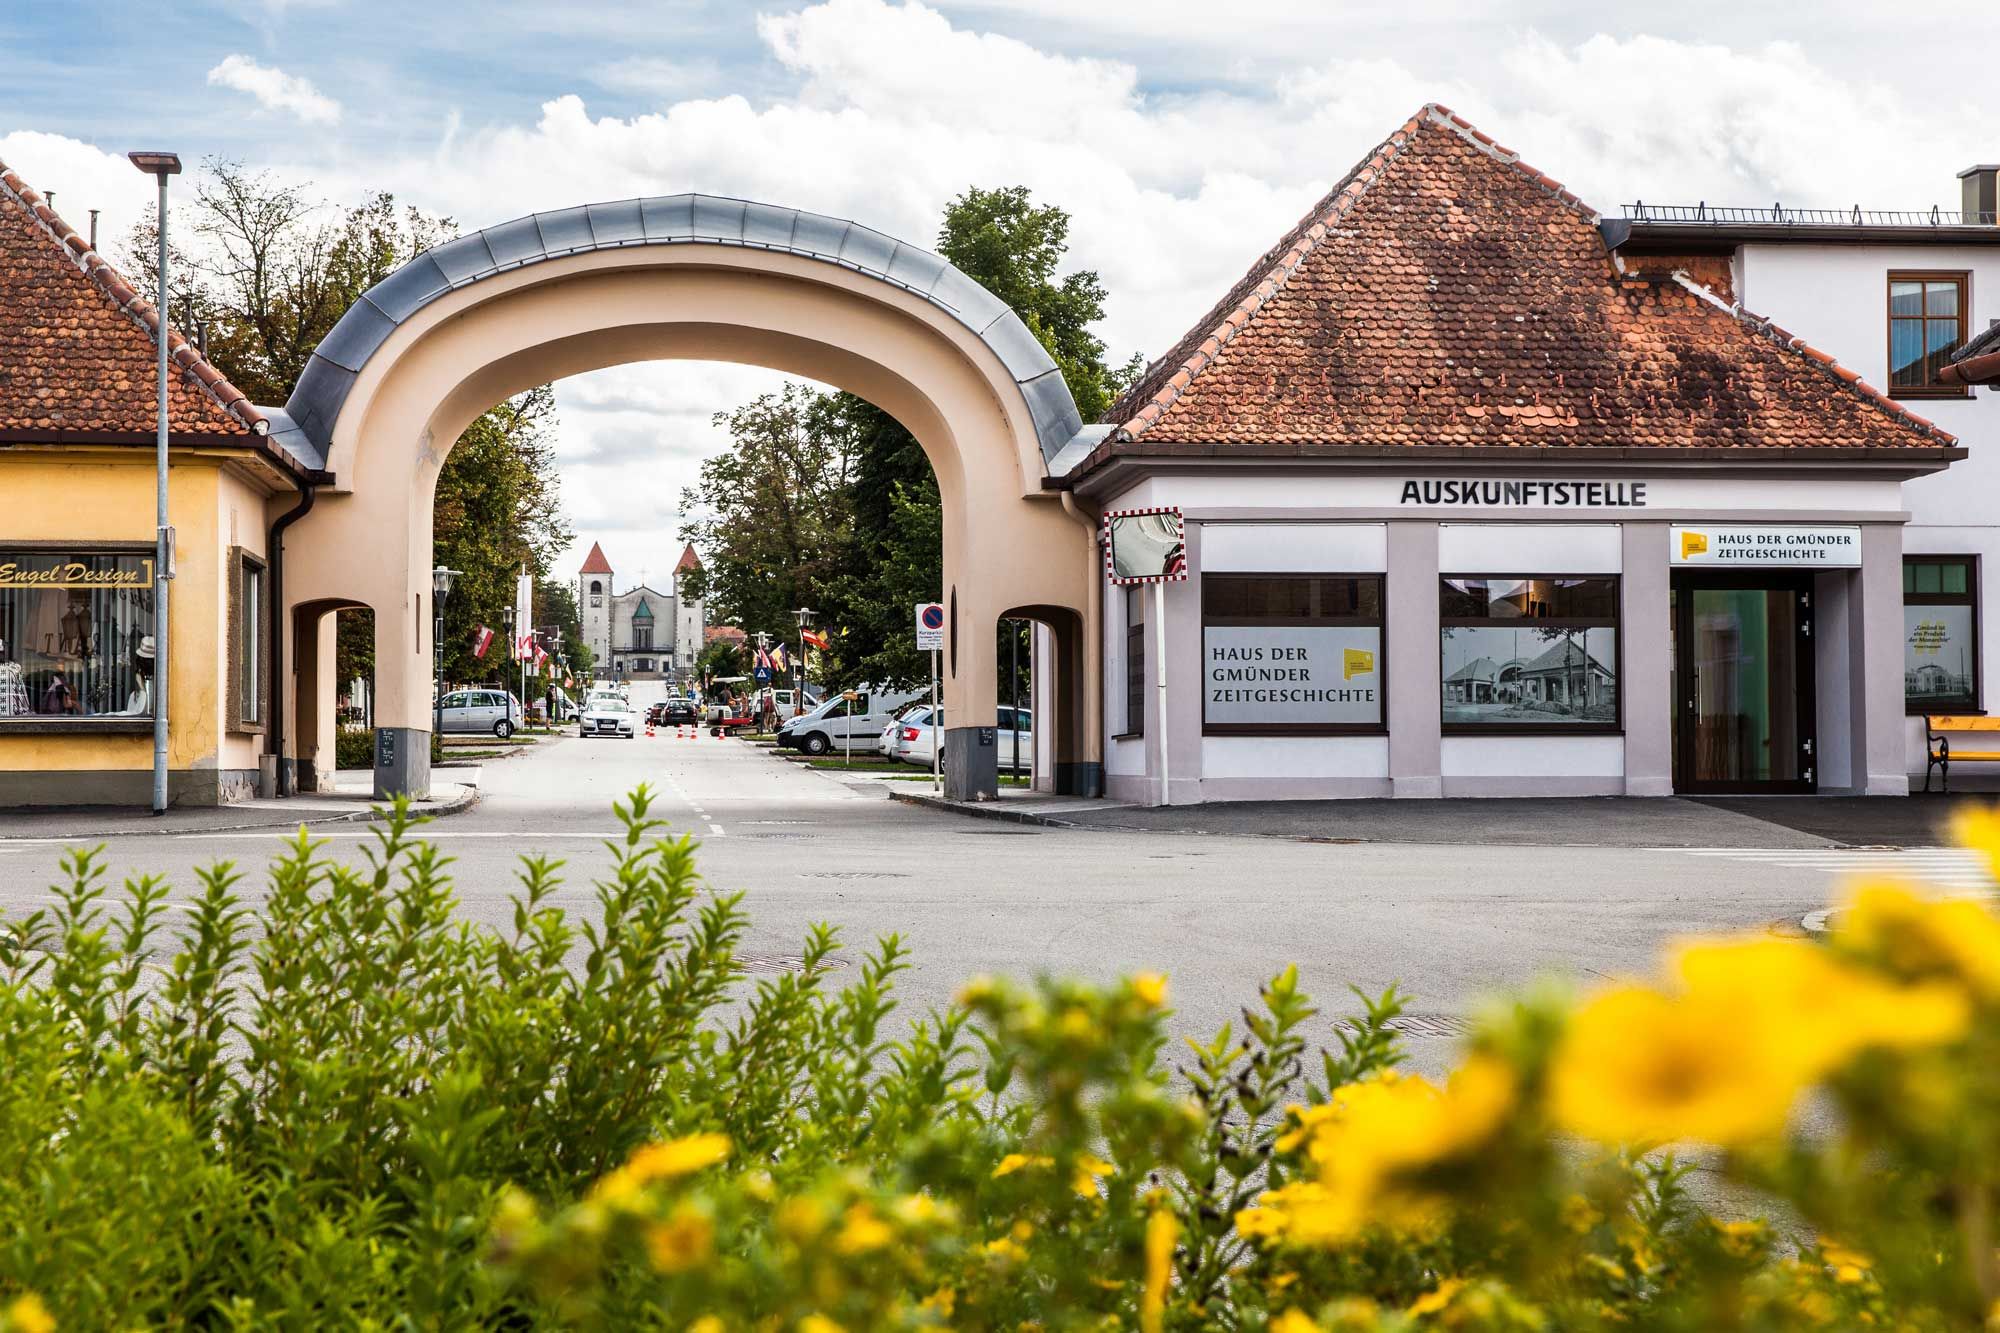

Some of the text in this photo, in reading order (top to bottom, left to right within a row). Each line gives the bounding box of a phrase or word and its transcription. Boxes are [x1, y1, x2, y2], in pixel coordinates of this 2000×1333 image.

[1401, 480, 1647, 506] AUSKUNFTSTELLE
[1719, 533, 1851, 545] HAUS DER GMÜNDER
[1718, 549, 1826, 559] ZEITGESCHICHTE
[0, 563, 138, 586] Engel Design
[1212, 647, 1308, 661] HAUS DER
[1212, 665, 1310, 682] GMÜNDER
[1212, 689, 1374, 703] ZEITGESCHICHTE
